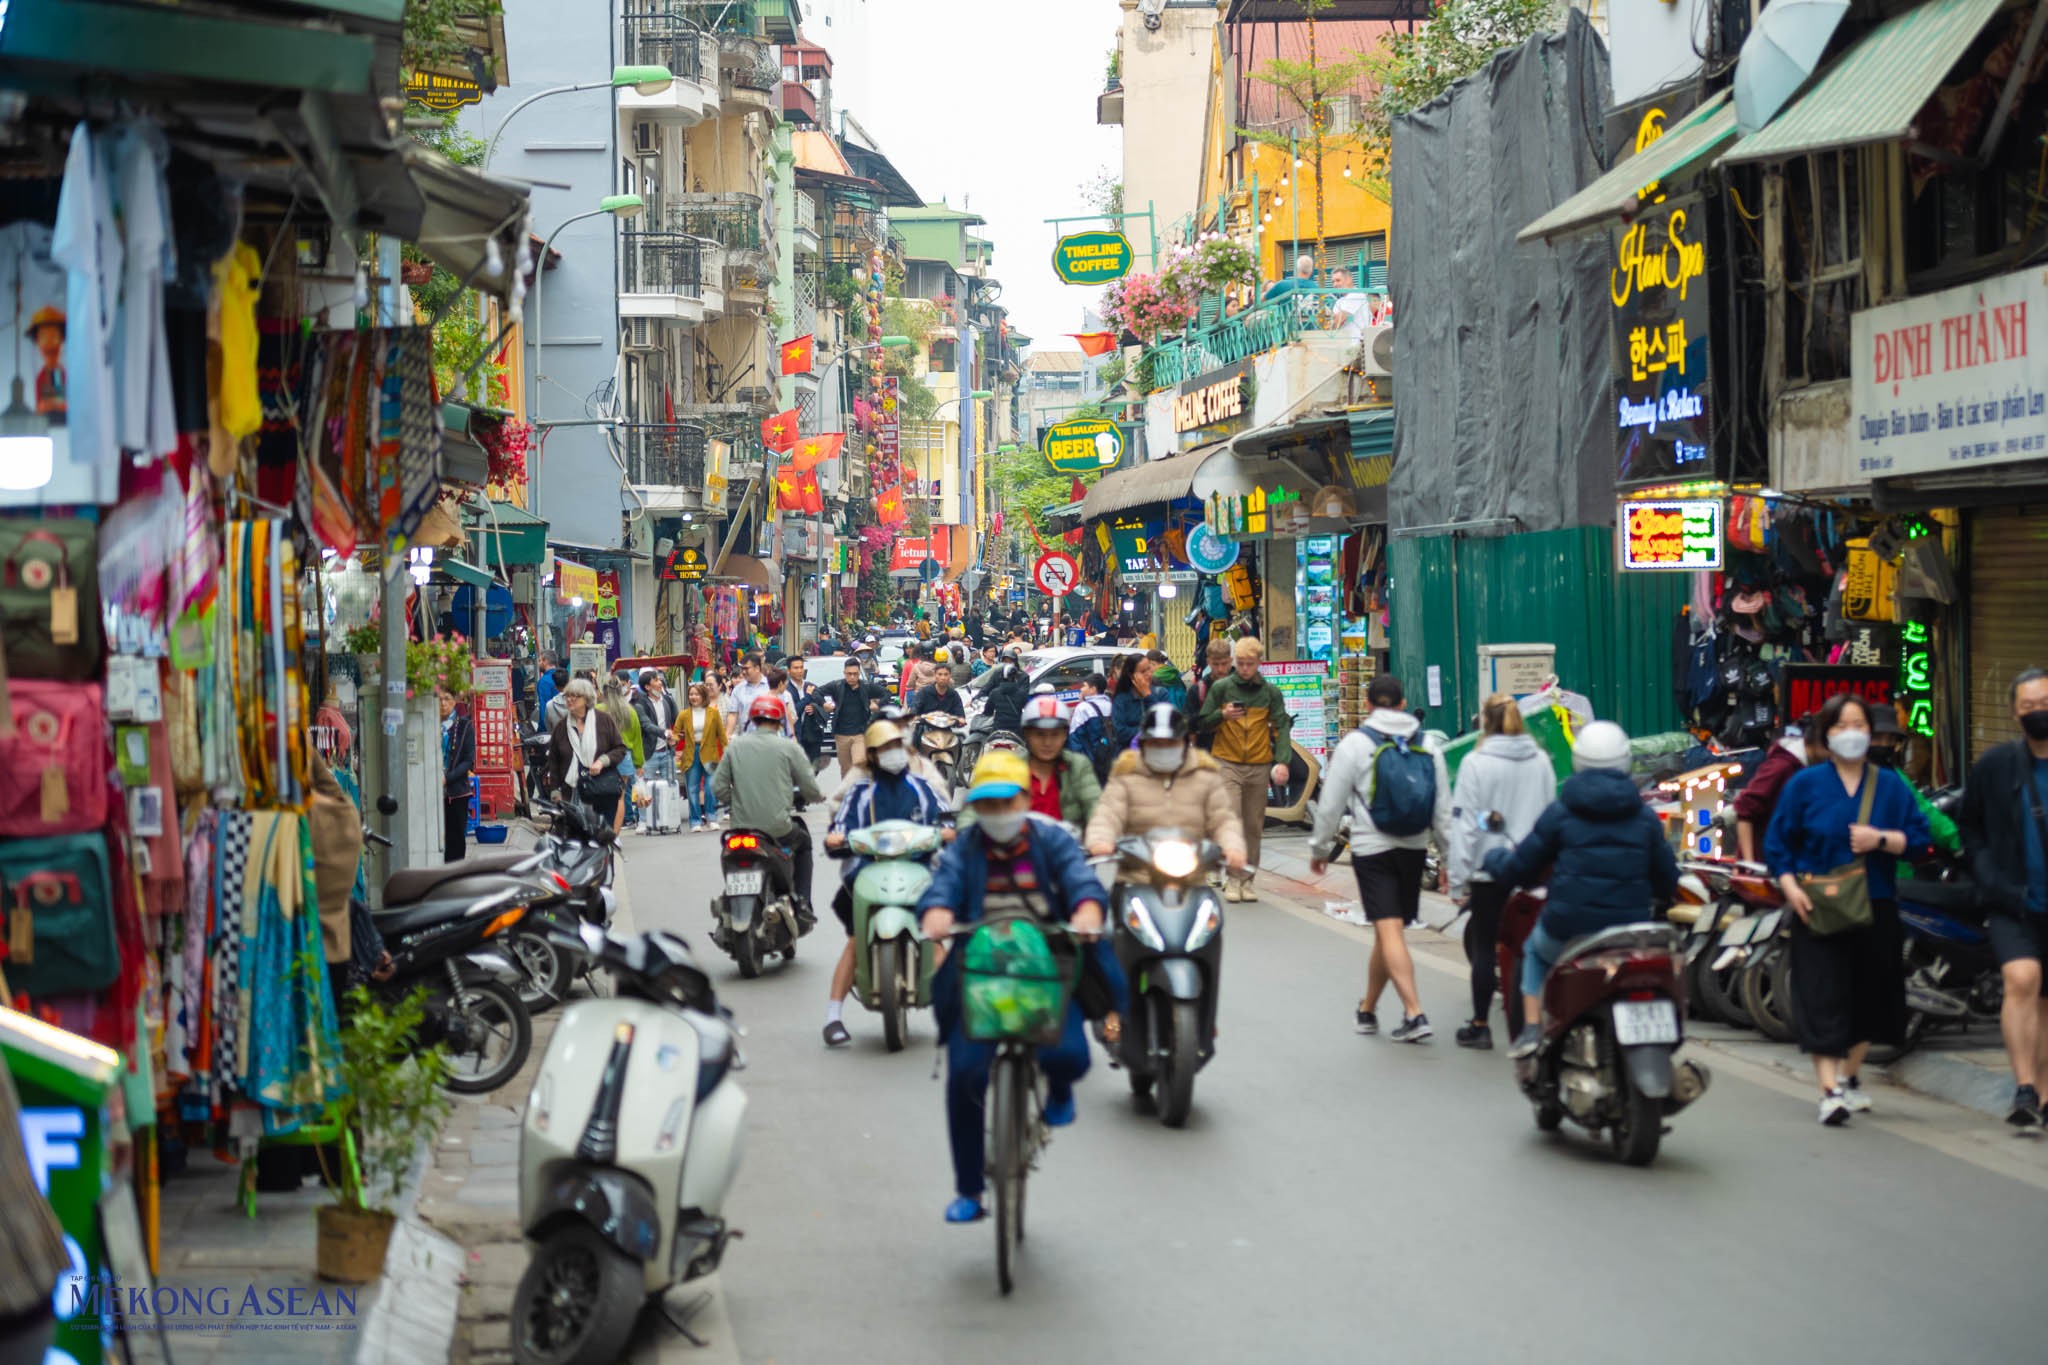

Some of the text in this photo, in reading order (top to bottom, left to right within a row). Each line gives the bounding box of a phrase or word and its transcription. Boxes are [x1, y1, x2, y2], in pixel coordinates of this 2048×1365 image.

[1063, 243, 1123, 258] TIMELINE
[1069, 258, 1119, 273] COFFEE
[1611, 209, 1704, 307] Han Spa
[1628, 318, 1687, 382] 한스파
[1940, 291, 2028, 372] THÀNH
[1172, 376, 1241, 433] TIMELINE COFFEE
[1619, 396, 1657, 434] Beauty
[1666, 387, 1704, 421] Relax
[1055, 423, 1111, 437] THE BALCONY
[1050, 438, 1096, 460] BEER
[1860, 628, 1871, 665] NORT
[1285, 662, 1327, 673] EXCHANGE
